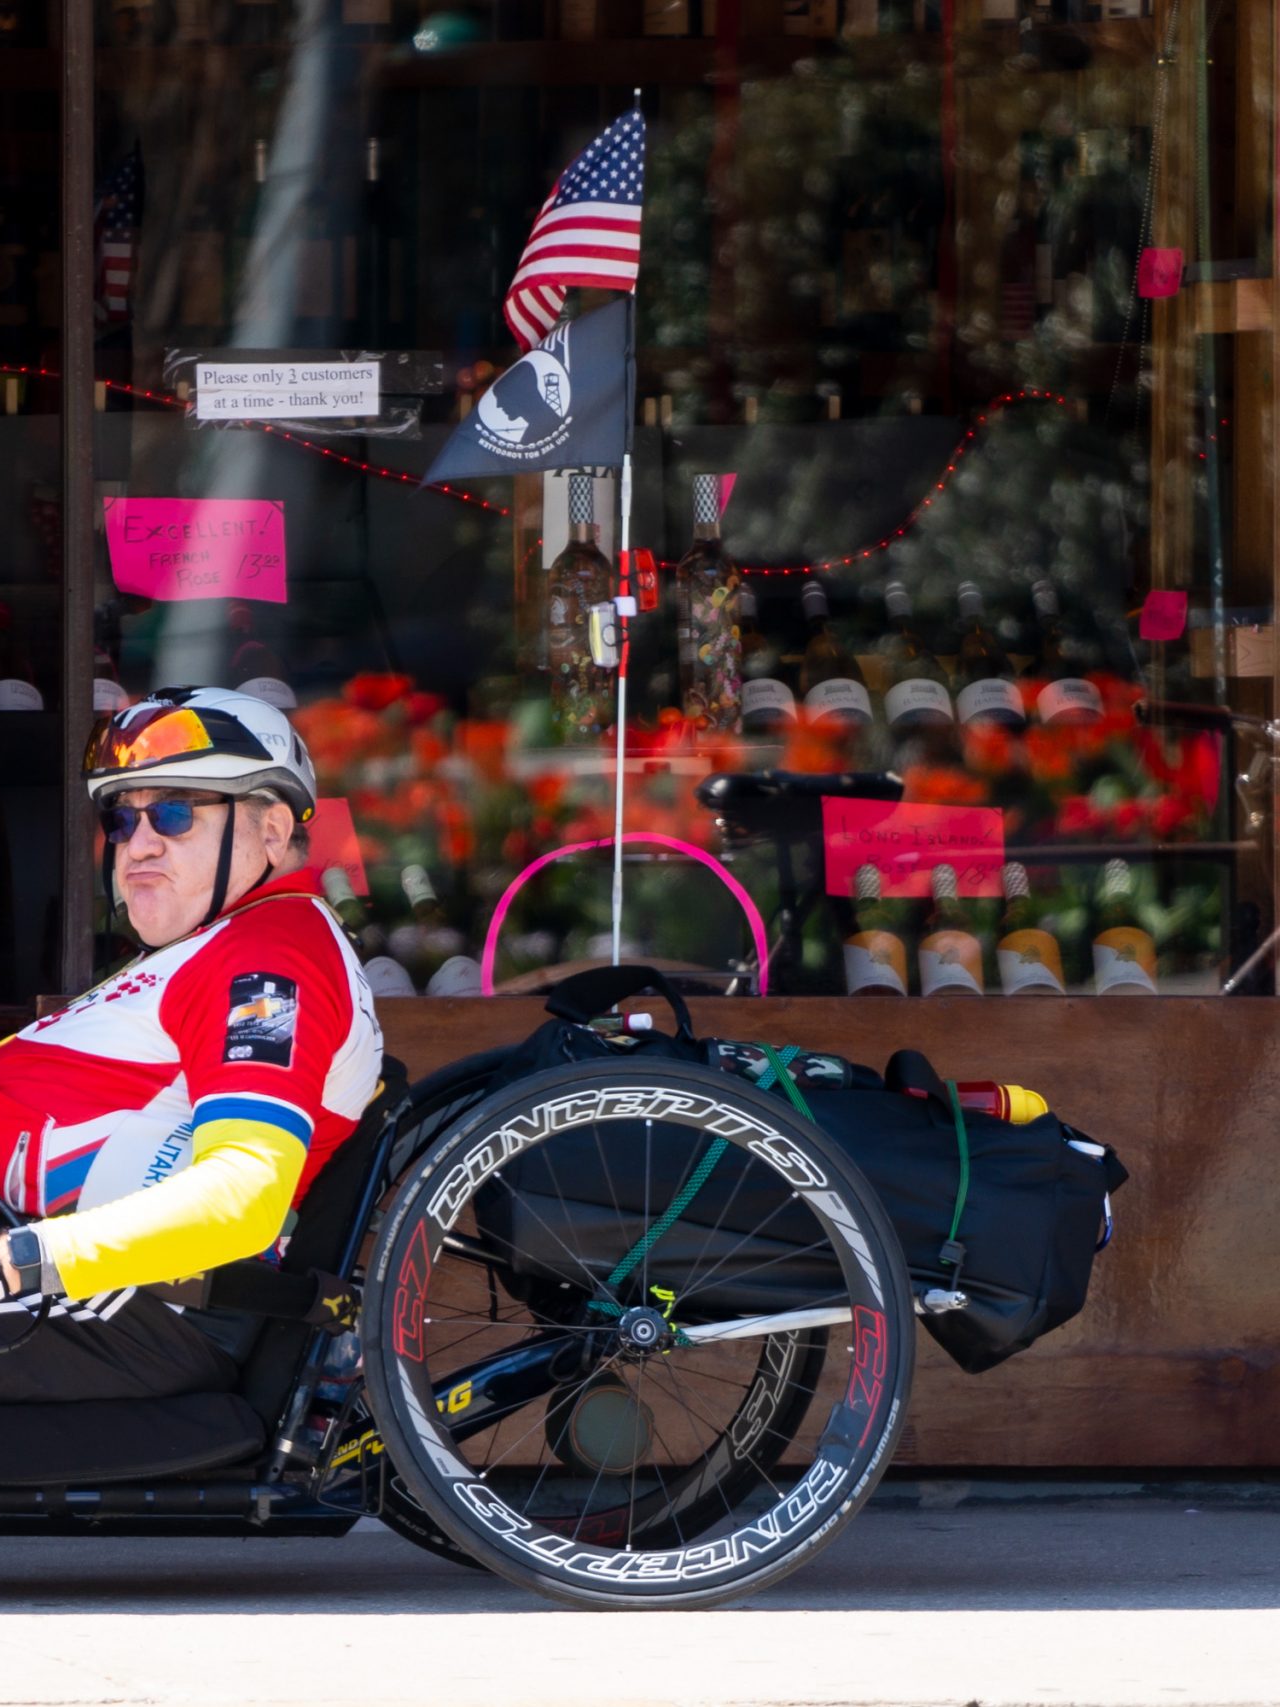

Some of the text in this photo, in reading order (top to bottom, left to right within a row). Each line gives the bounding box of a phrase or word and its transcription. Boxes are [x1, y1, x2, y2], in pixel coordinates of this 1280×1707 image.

[203, 367, 373, 385] Please only 3 customers
[214, 396, 226, 409] at
[231, 398, 239, 409] a
[243, 393, 275, 409] time
[289, 391, 328, 407] thank
[332, 390, 365, 409] you!
[123, 509, 274, 544] EXCELLENT!
[141, 1121, 194, 1189] MILITAR
[426, 1086, 828, 1231] CONCEPTS
[376, 1180, 420, 1282] SCHWALBE
[851, 1397, 901, 1498] SCHWALBE
[453, 1460, 849, 1582] CONCEPTS
